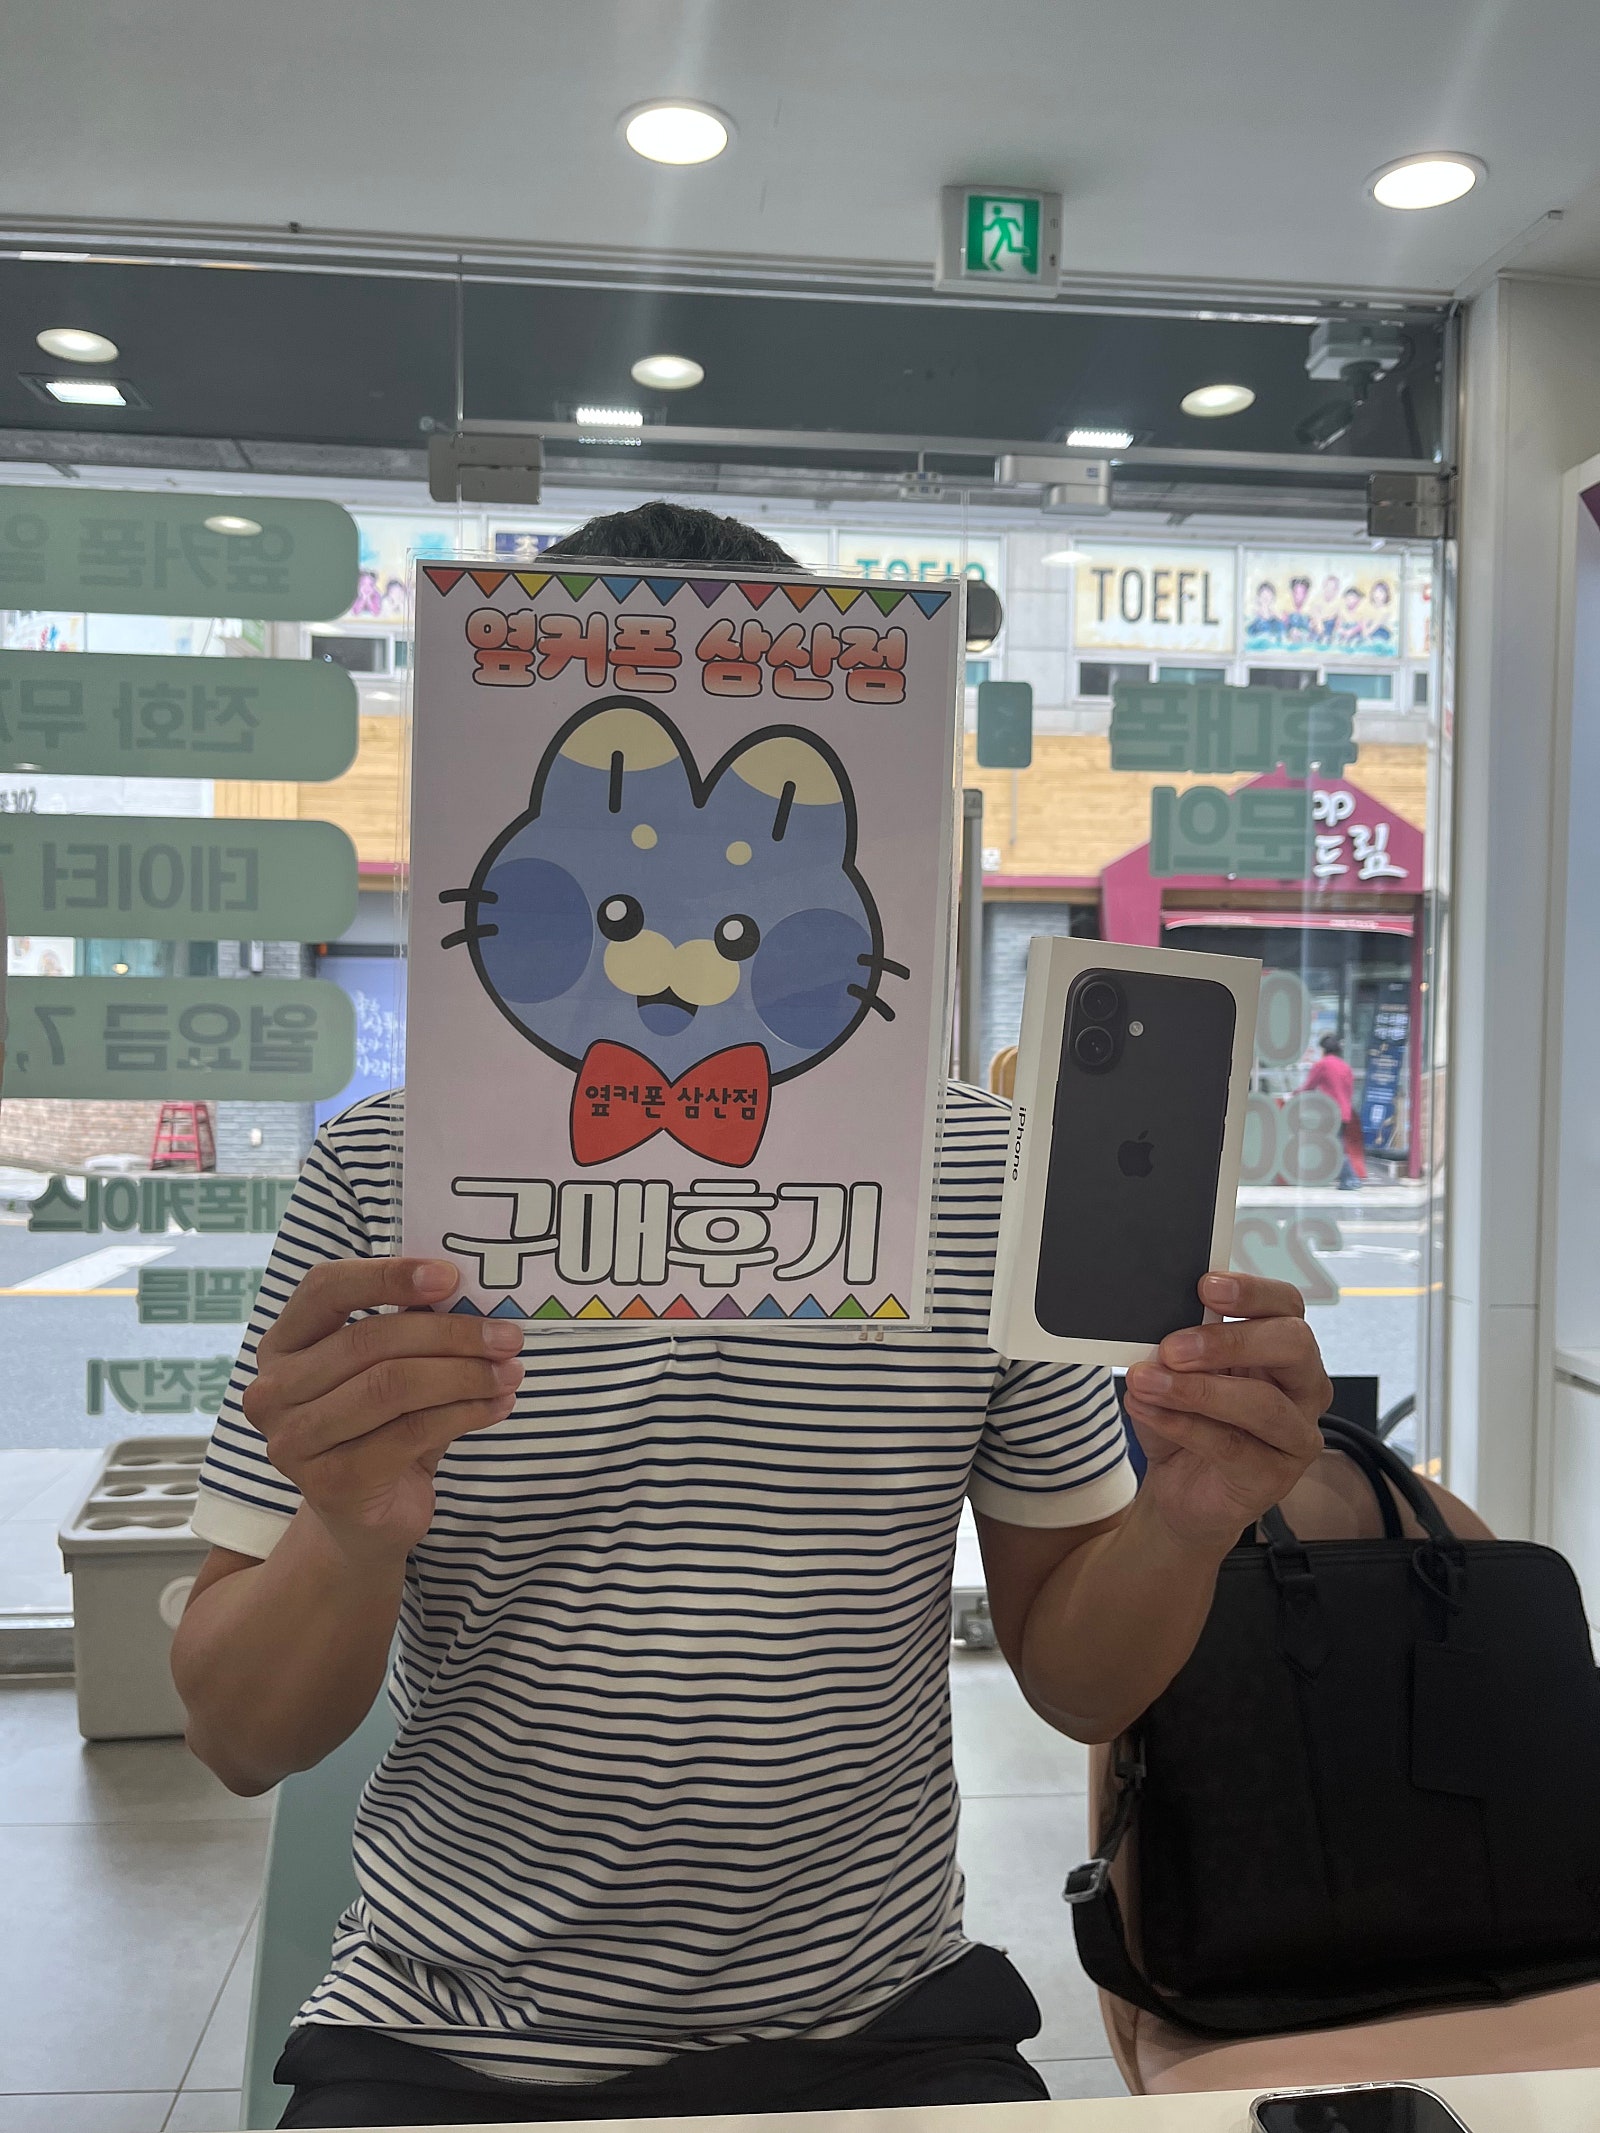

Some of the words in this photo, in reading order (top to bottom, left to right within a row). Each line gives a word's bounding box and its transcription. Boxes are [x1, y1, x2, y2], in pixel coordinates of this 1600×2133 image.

[1090, 566, 1220, 626] TOEFL
[465, 607, 682, 693] 옆커폰
[695, 618, 908, 704] 삼산점
[584, 1084, 667, 1119] 옆커폰
[677, 1086, 760, 1121] 삼산점
[1011, 1106, 1027, 1181] iPhone
[442, 1175, 883, 1290] 구매후기
